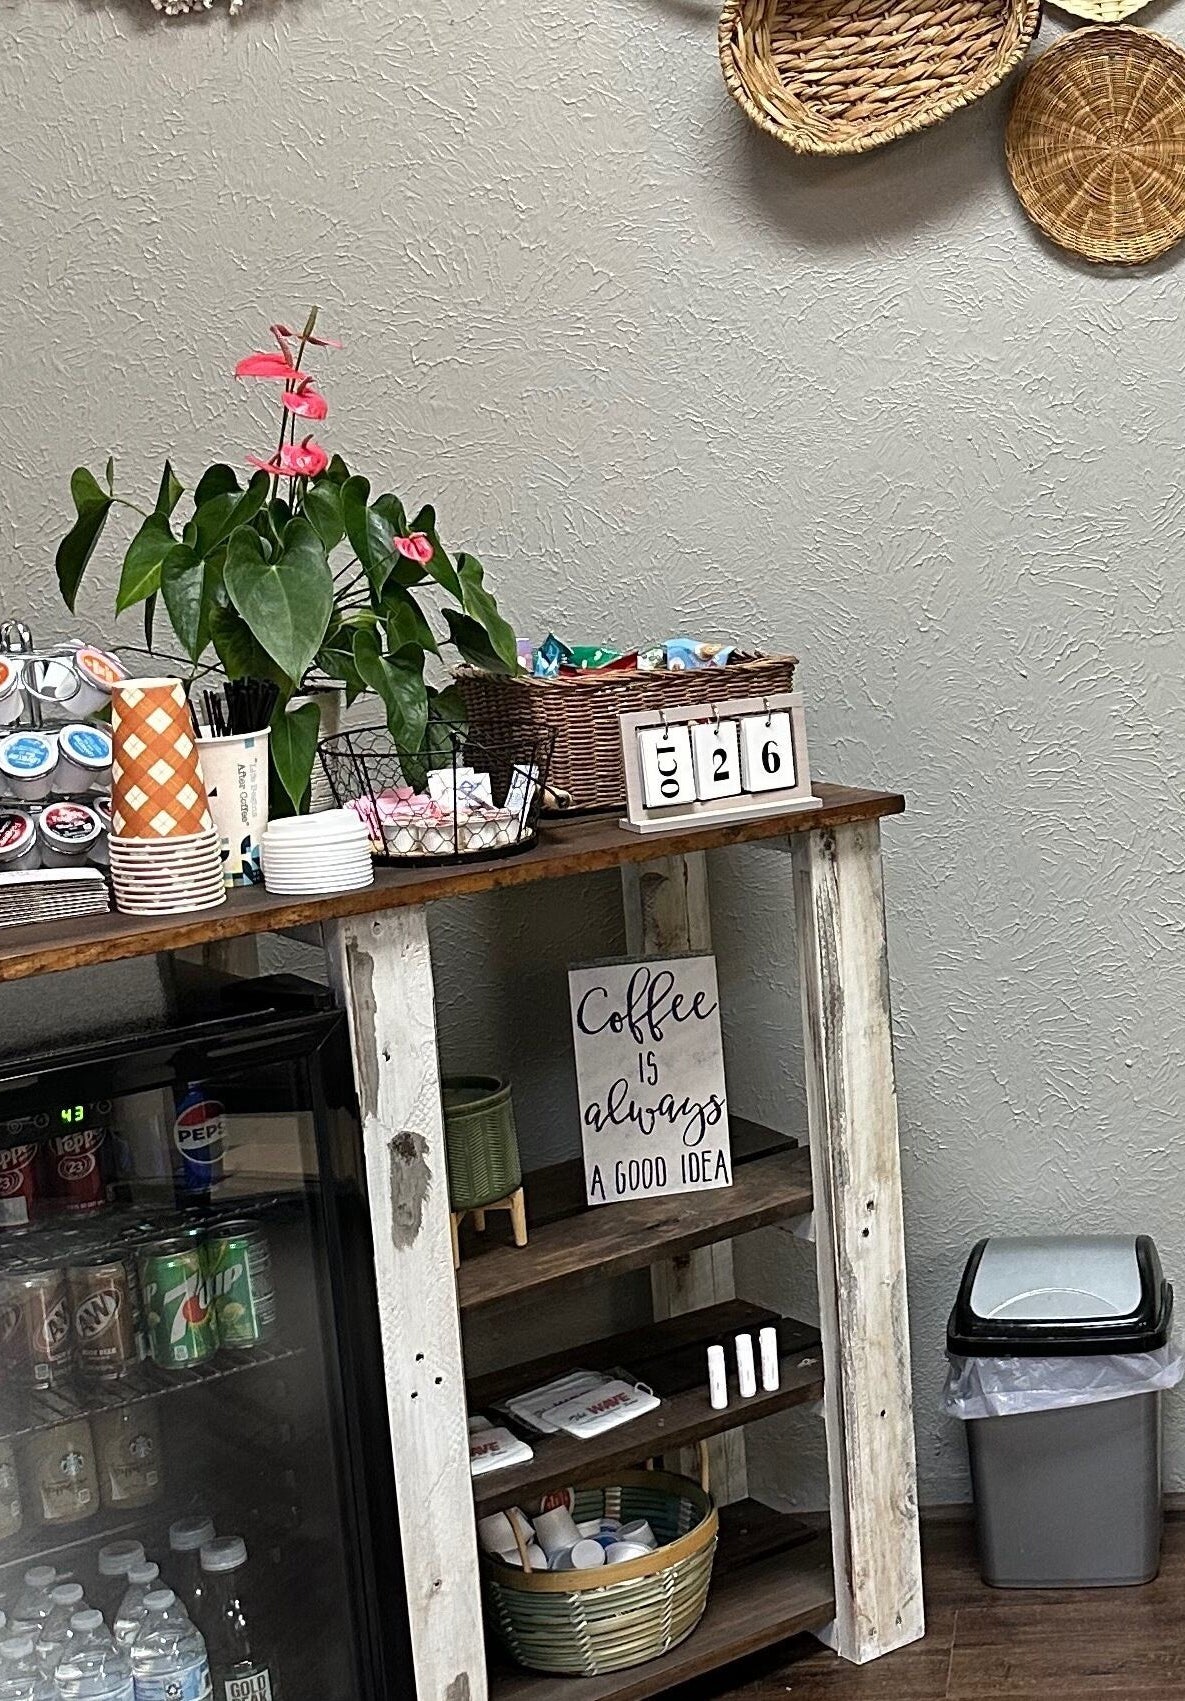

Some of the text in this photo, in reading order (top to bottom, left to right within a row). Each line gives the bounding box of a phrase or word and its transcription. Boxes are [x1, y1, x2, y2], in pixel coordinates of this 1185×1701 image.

[237, 763, 247, 790] After
[656, 740, 781, 798] OCT 2 6
[576, 966, 718, 1045] Coffee
[638, 1050, 659, 1086] IS
[61, 1105, 84, 1123] 43
[584, 1077, 726, 1147] always
[178, 1121, 225, 1143] PEPS
[590, 1149, 730, 1201] A GOOD IDEA
[586, 1391, 632, 1415] WAVE
[471, 1441, 500, 1457] AVE
[230, 1674, 266, 1697] GOLD
